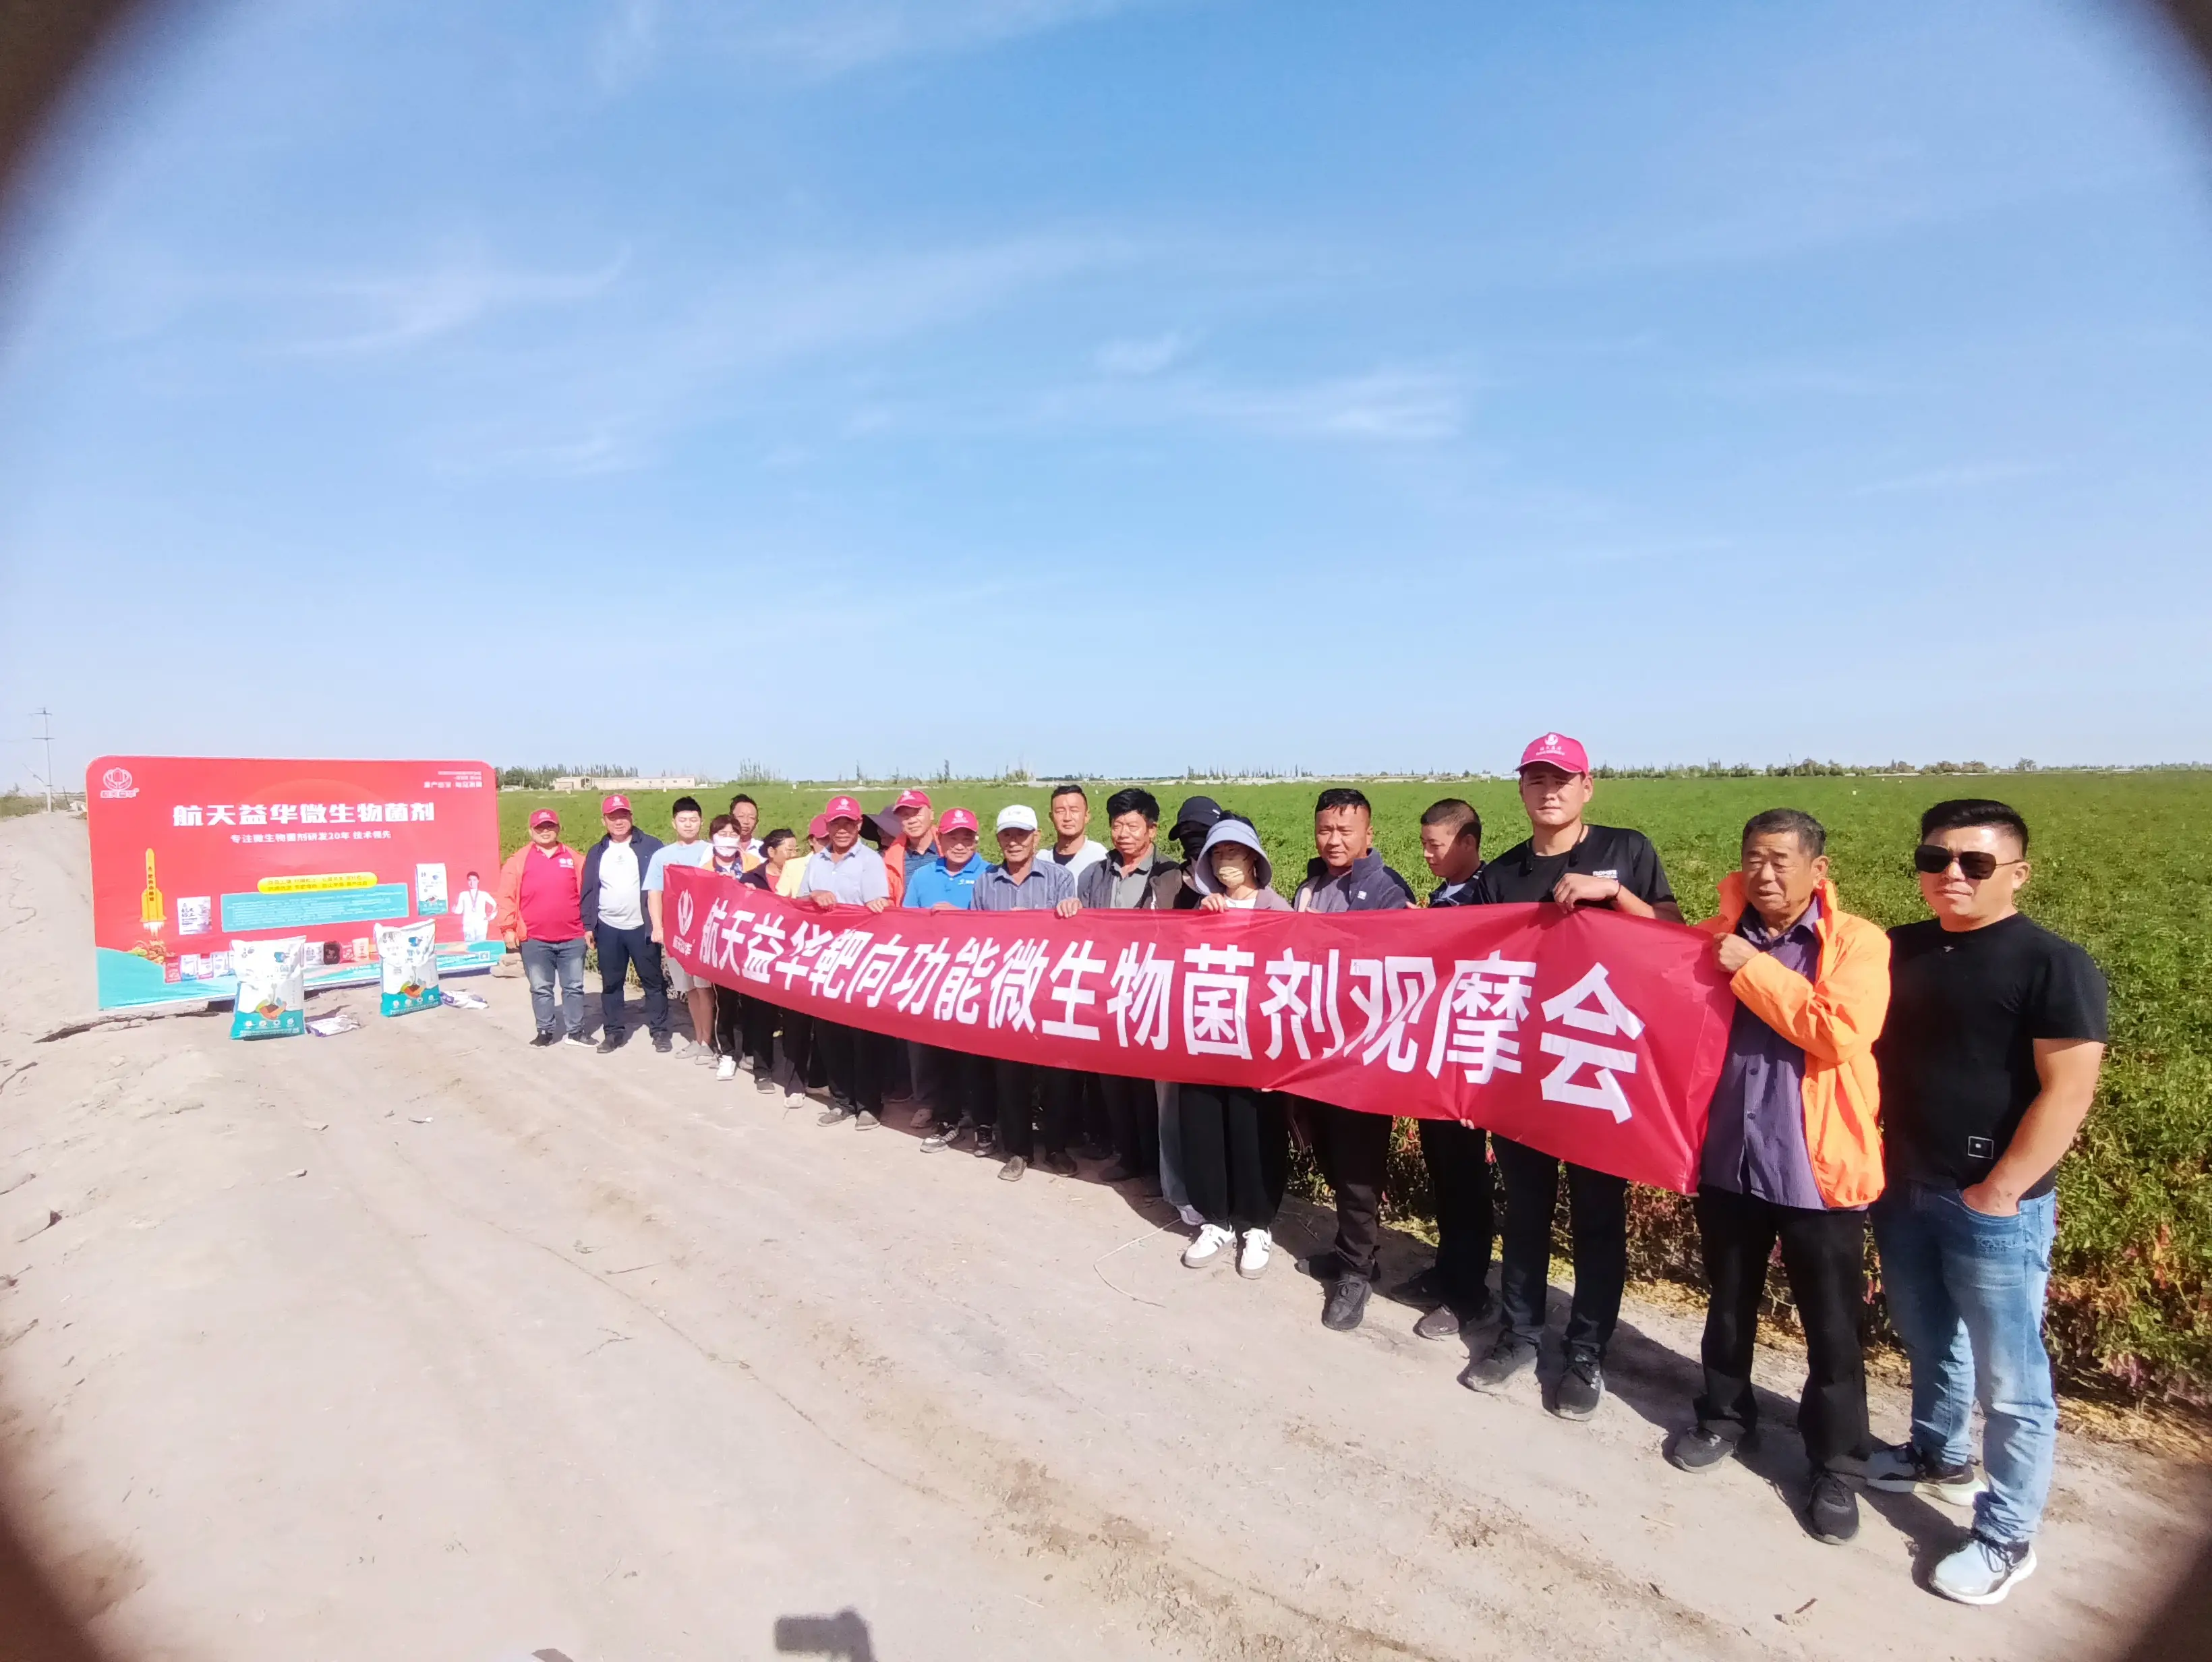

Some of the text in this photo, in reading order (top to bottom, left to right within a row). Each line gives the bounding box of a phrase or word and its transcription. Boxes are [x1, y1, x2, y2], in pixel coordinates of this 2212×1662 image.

[173, 802, 435, 827] 航天益华微生物菌剂
[699, 896, 1646, 1124] 航天益华靶向功能微生物菌剂观摩会
